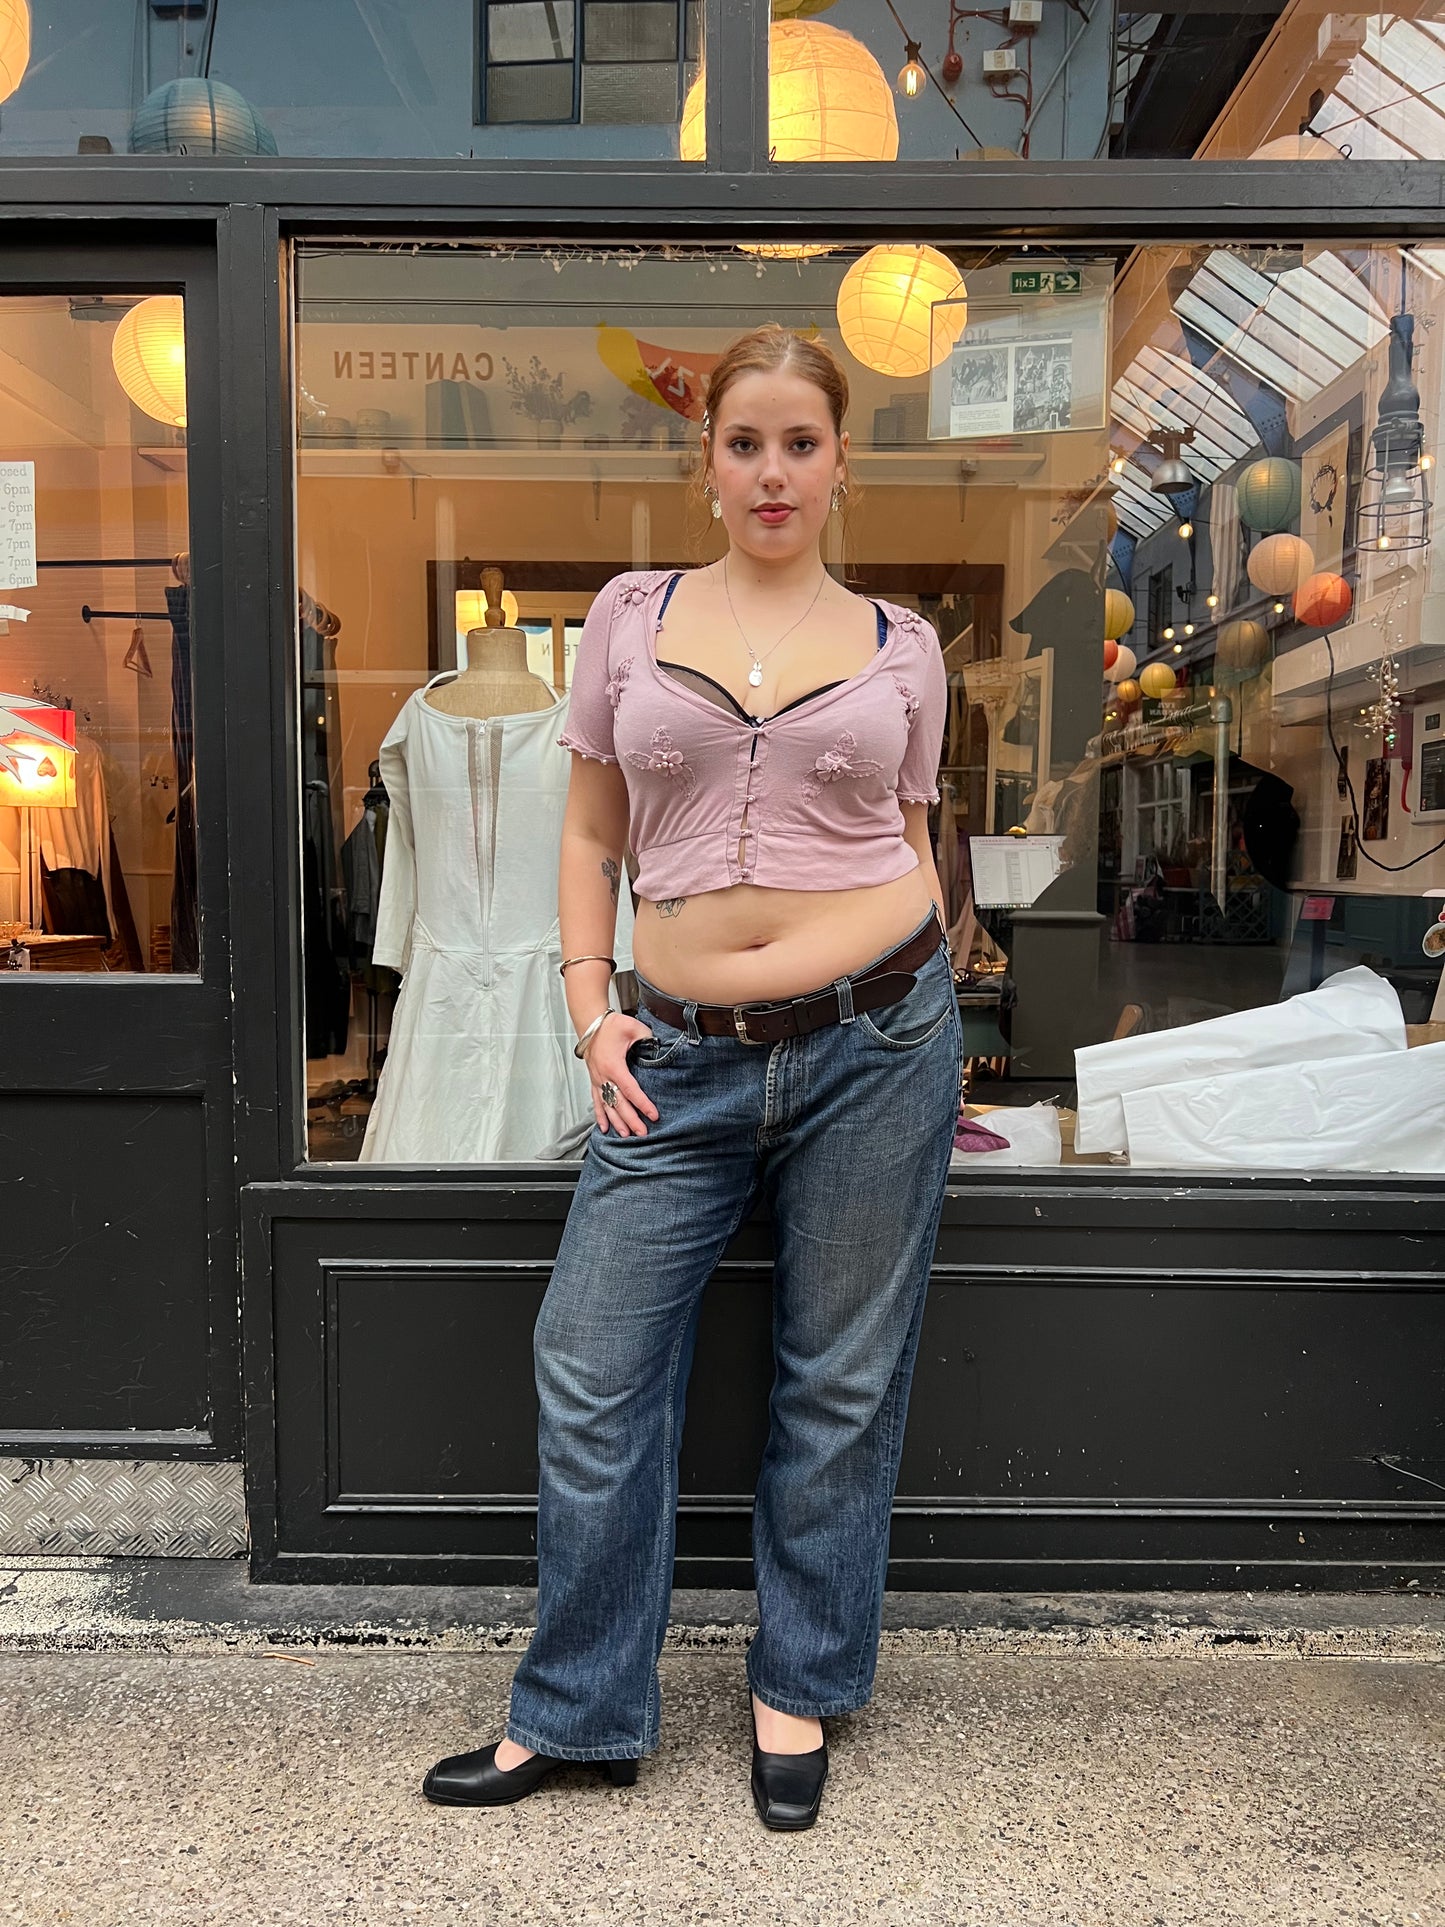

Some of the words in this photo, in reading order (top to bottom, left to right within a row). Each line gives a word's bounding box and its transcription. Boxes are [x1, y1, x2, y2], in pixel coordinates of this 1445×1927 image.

[4, 483, 30, 498] 6pm
[8, 501, 33, 516] 6pm
[8, 519, 32, 534] 7pm
[6, 538, 30, 553] 7pm
[8, 556, 31, 571] 7pm
[9, 573, 33, 588] 6pm
